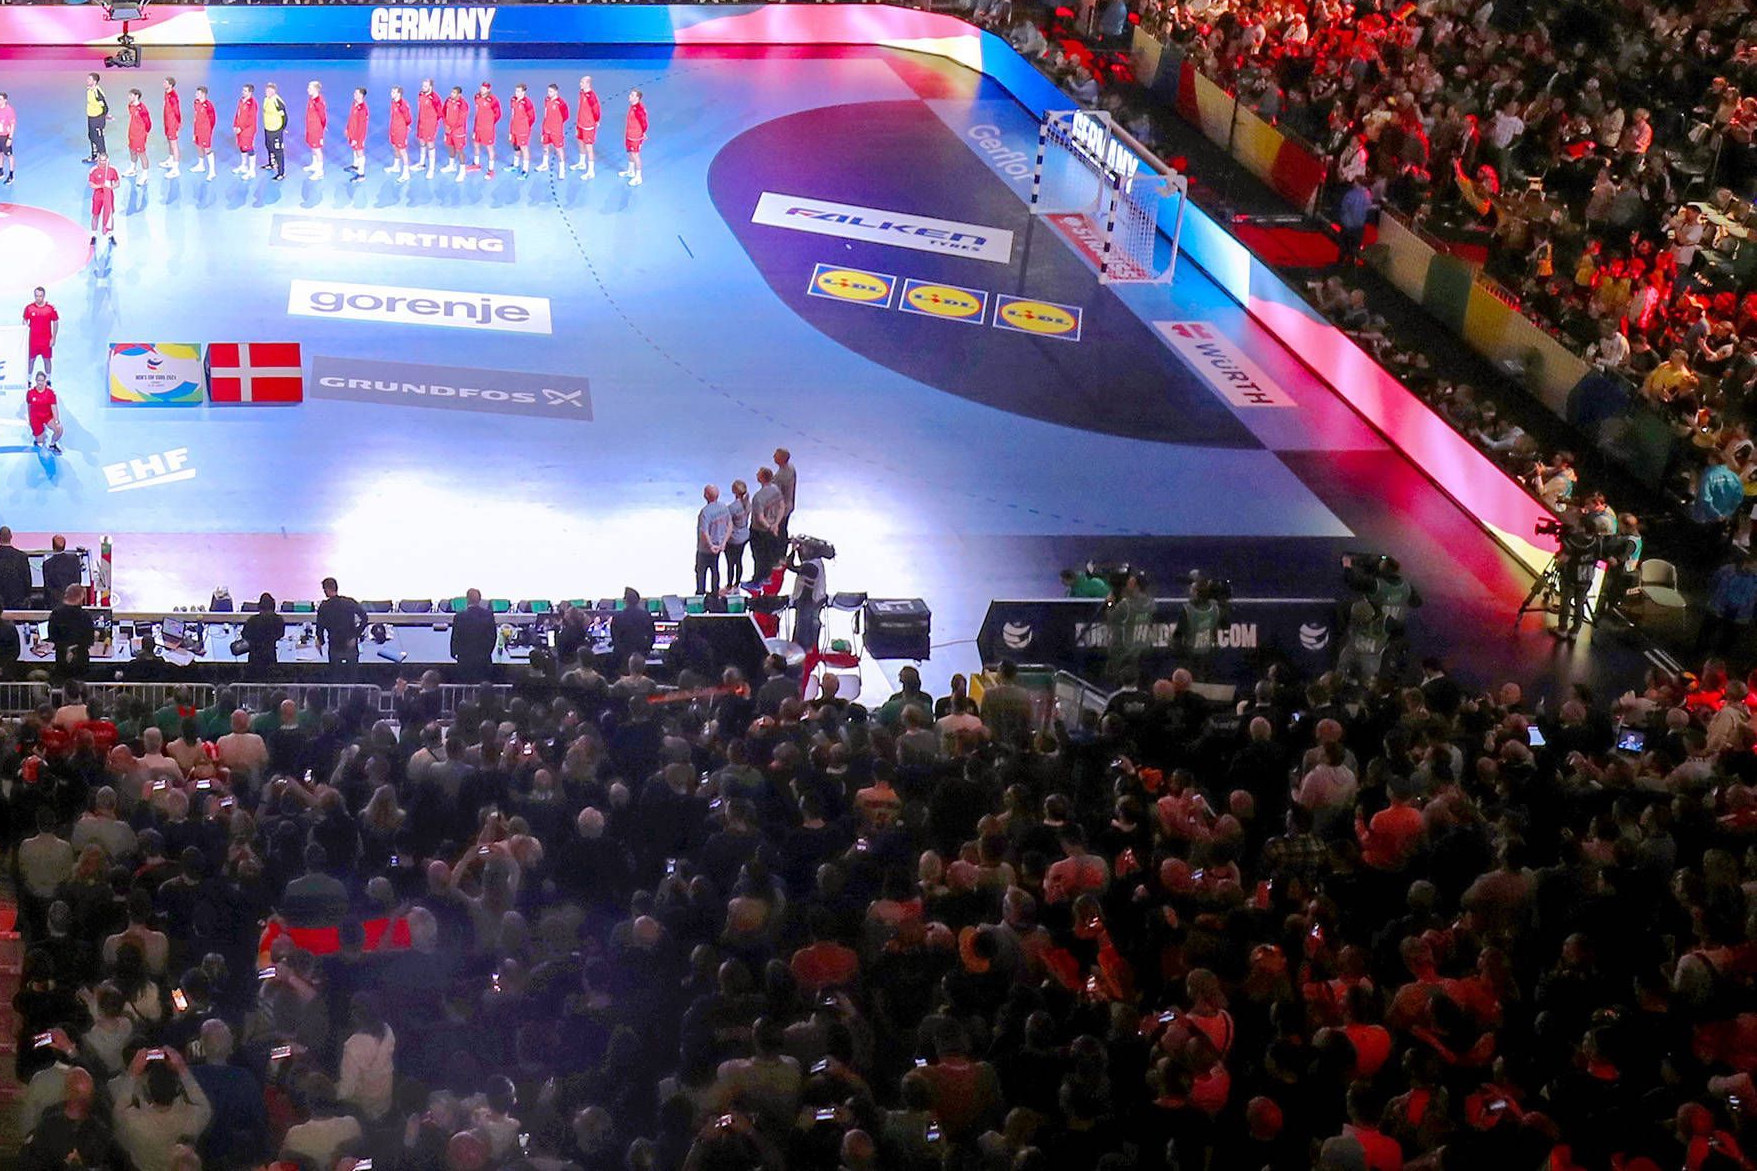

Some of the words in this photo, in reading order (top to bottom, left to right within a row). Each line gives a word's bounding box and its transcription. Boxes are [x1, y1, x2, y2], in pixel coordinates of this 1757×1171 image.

[371, 7, 495, 40] GERMANY
[342, 226, 503, 253] HARTING
[785, 207, 987, 246] FALKEN
[929, 239, 981, 252] TYRES
[310, 291, 530, 324] gorenje
[319, 376, 536, 404] GRUNDFOS
[1195, 343, 1274, 404] WÜRTH
[102, 446, 188, 488] EHF
